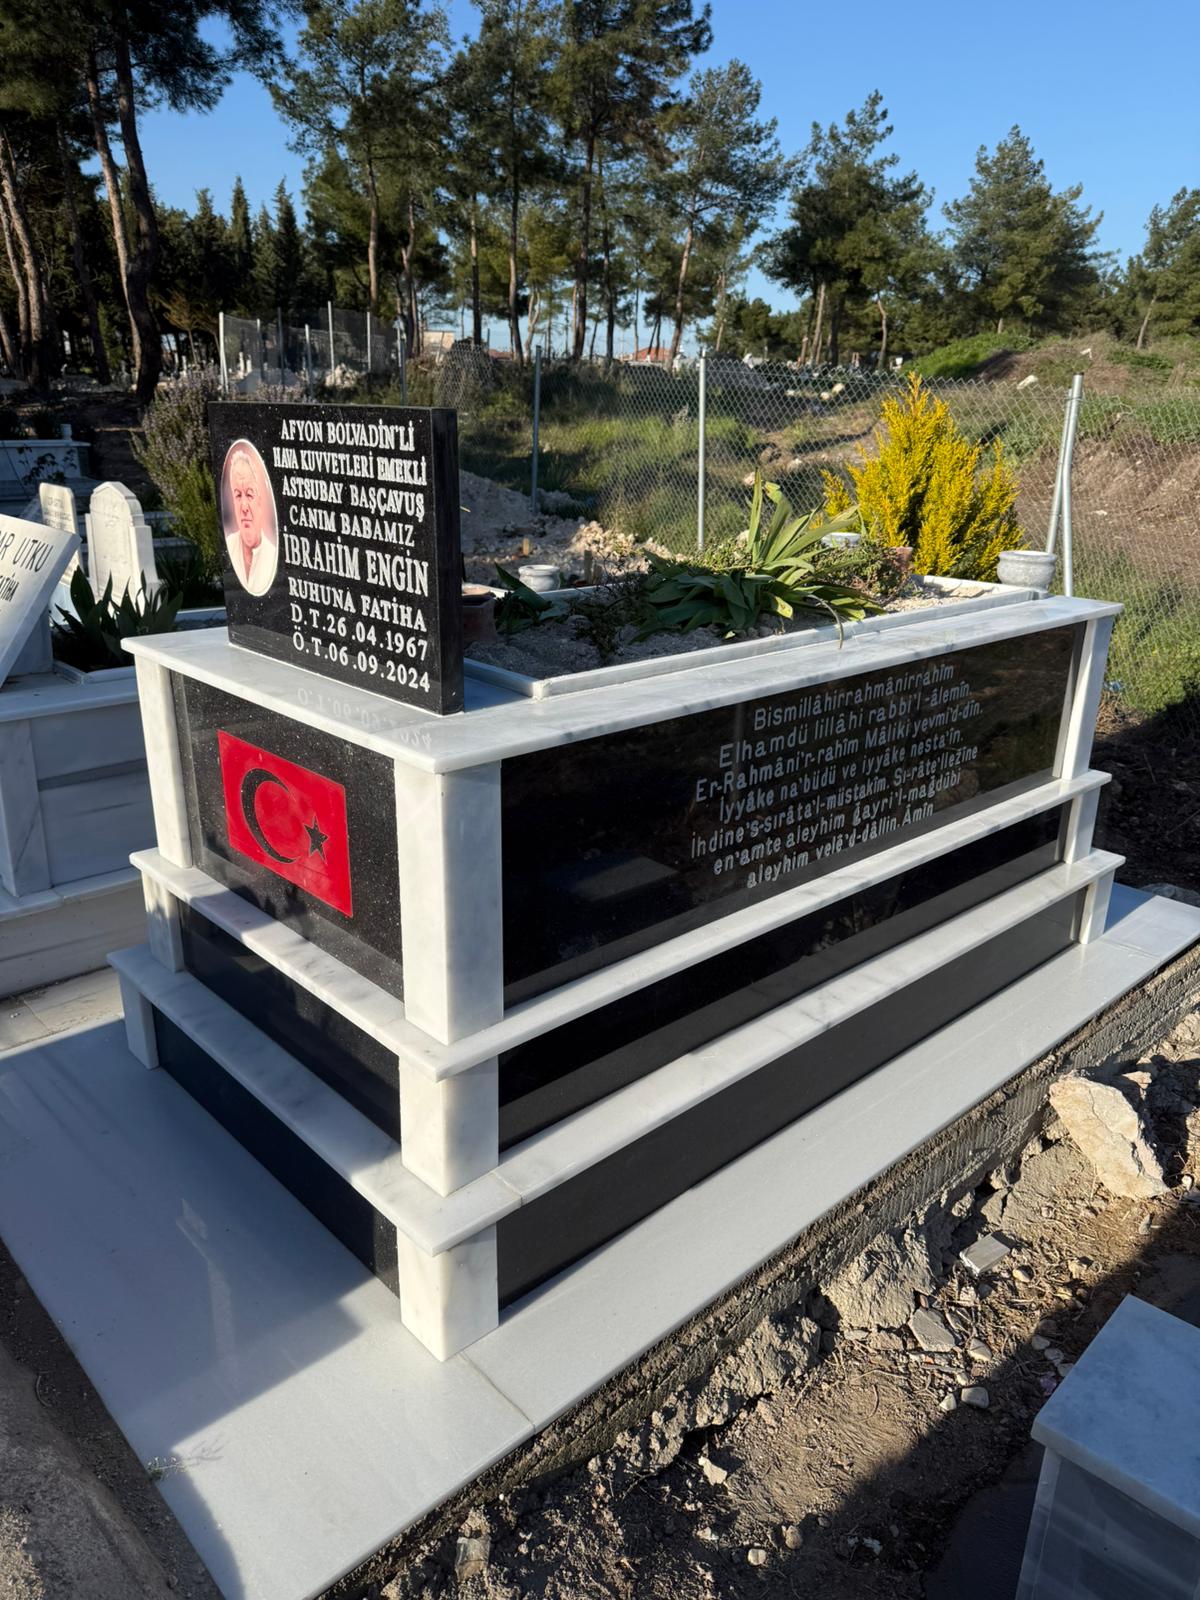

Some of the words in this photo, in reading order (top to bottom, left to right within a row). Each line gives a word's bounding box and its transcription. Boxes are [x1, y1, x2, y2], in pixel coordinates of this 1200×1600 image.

[281, 419, 323, 443] AFYON
[327, 418, 415, 451] BOLVADİN'Lİ
[273, 447, 299, 469] HAVA
[300, 450, 374, 478] KUVVETLERİ
[377, 456, 427, 486] EMEKLİ
[282, 475, 344, 504] ASTSUBAY
[350, 484, 425, 522] BAŞÇAVUŞ
[289, 505, 337, 532] CANIM
[340, 513, 415, 547] BABAMIZ
[13, 537, 54, 573] UTKU
[283, 525, 361, 581] İBRAHİM
[365, 549, 429, 597] ENGİN
[288, 577, 356, 613] RUHUNA
[361, 597, 427, 632] FATİHA
[720, 723, 808, 768] Elhamdü
[865, 719, 909, 750] Mâliki
[842, 763, 856, 779] ve
[862, 745, 906, 775] iyyâke
[786, 813, 845, 848] aleyhim
[747, 849, 809, 889] aleyhim
